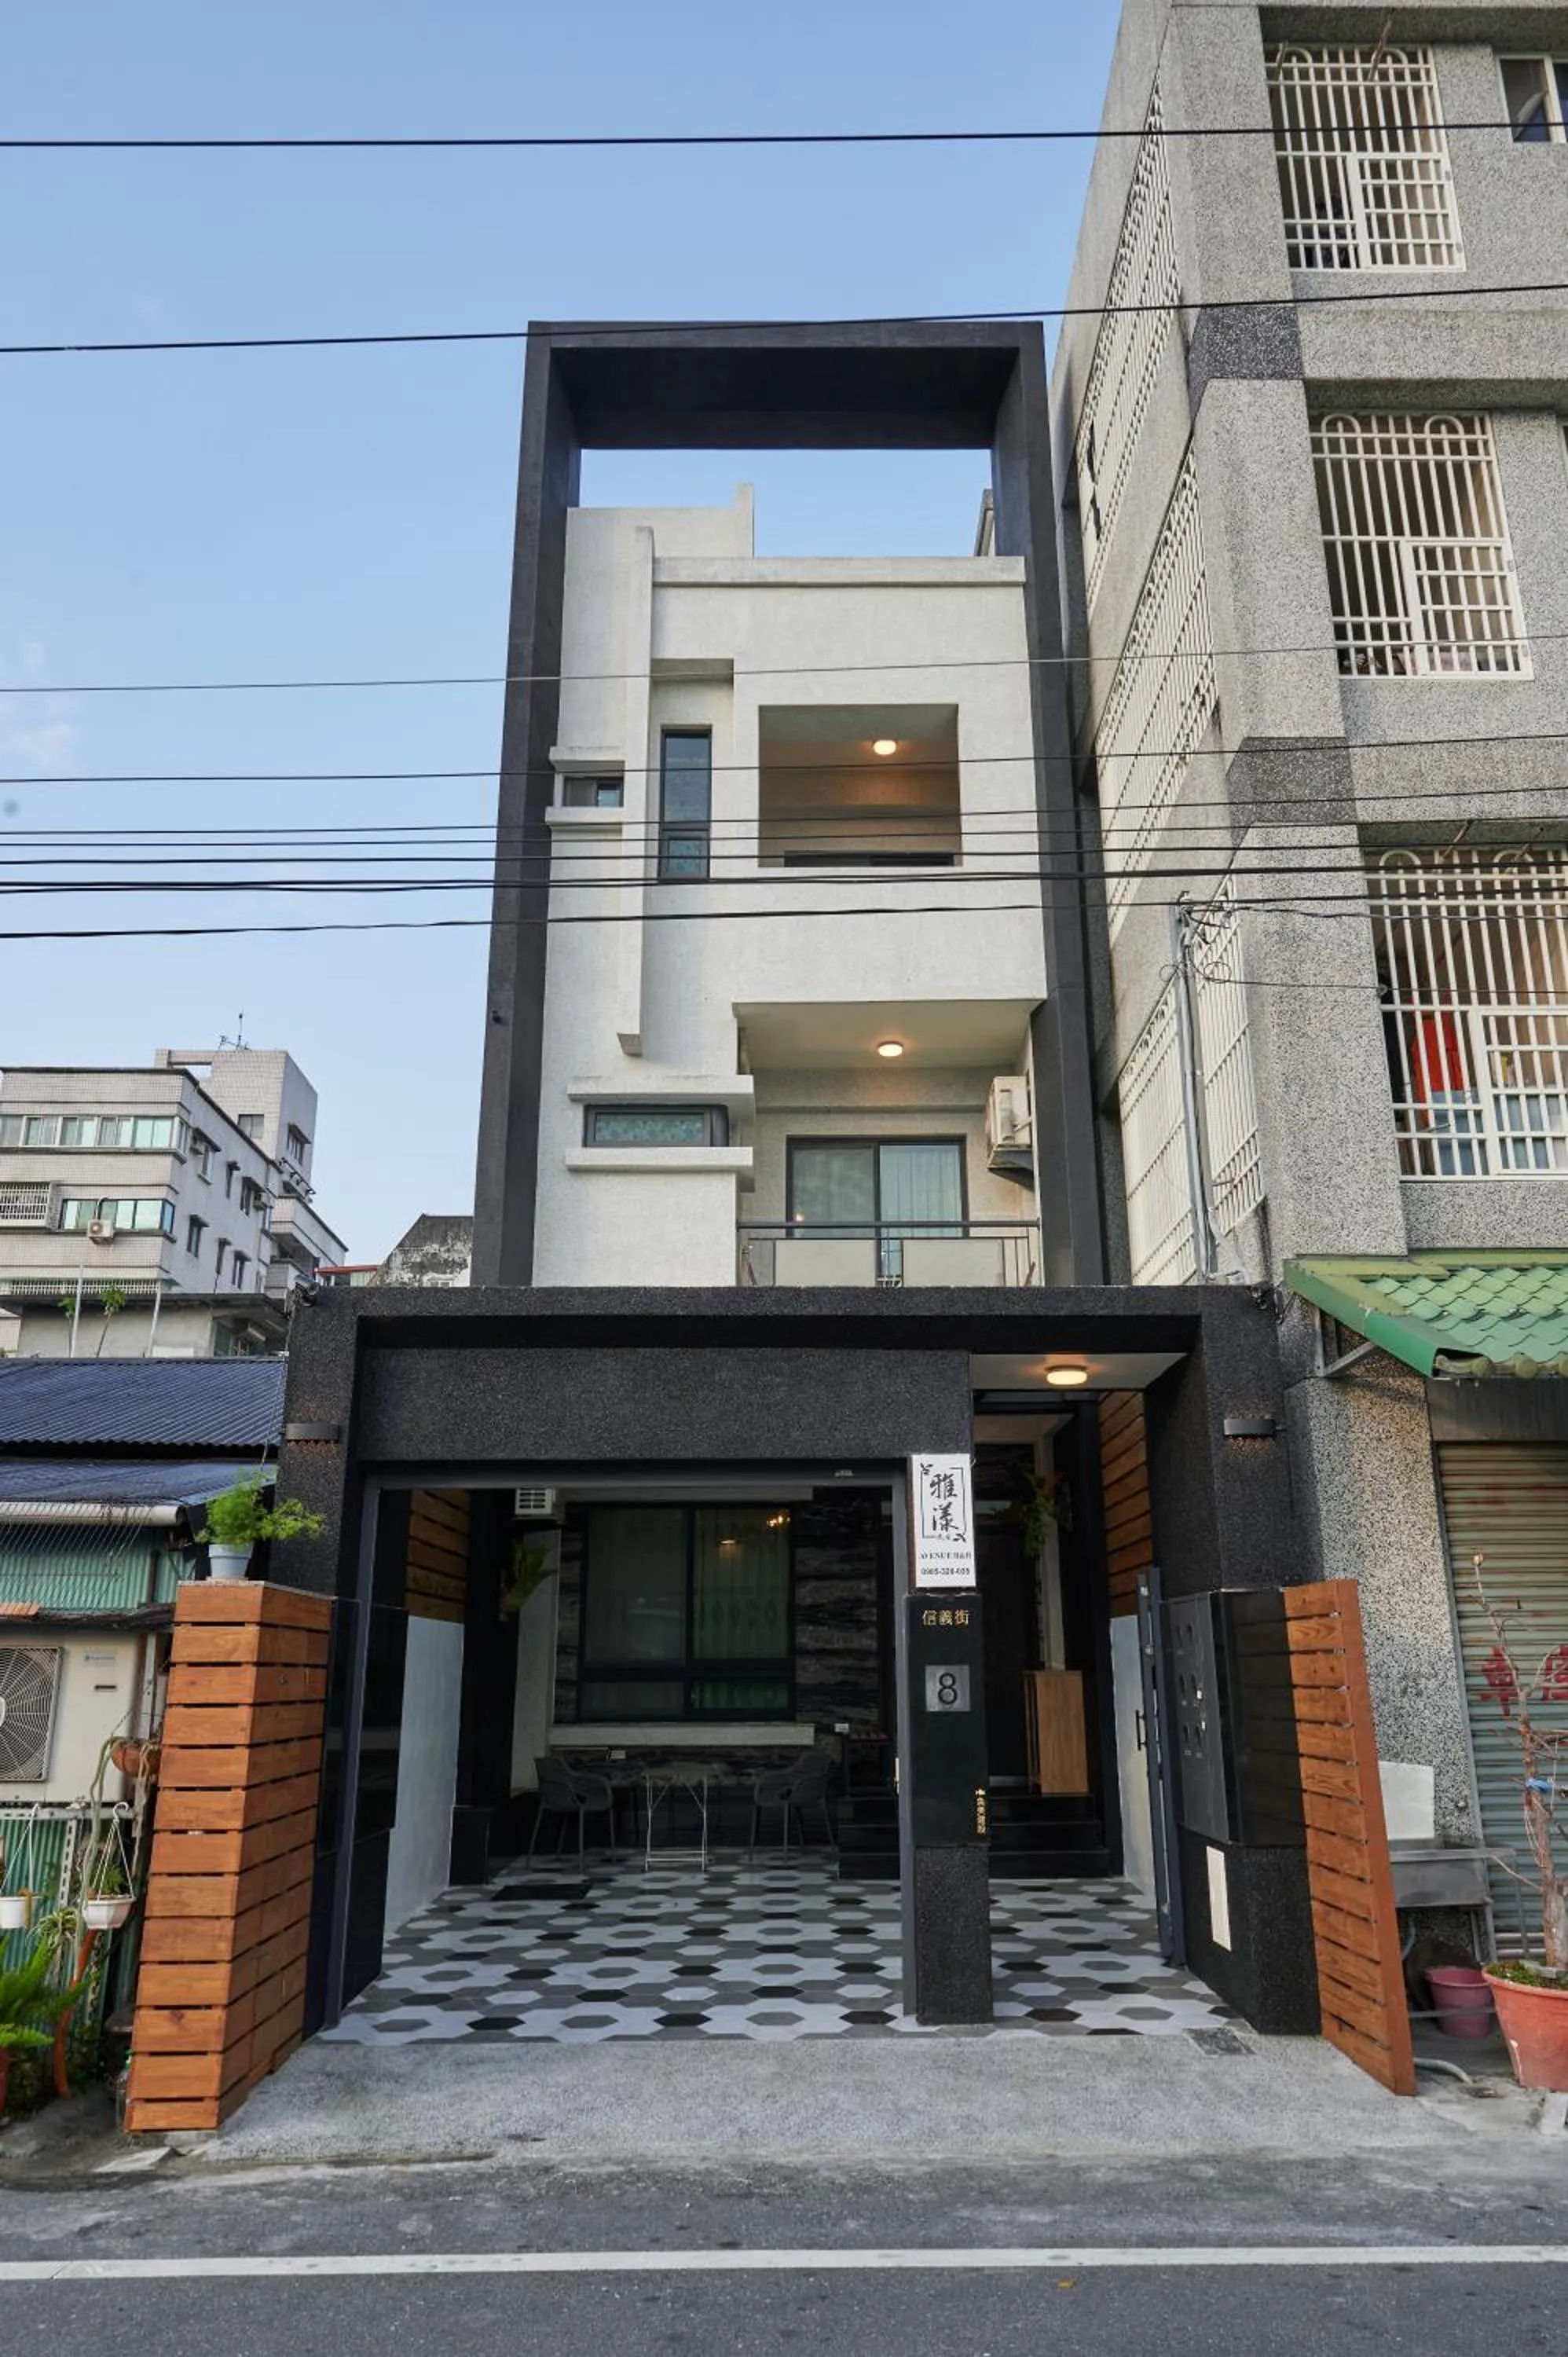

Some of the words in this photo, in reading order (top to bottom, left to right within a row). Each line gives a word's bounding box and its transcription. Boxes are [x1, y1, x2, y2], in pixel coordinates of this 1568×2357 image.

[922, 1609, 970, 1626] 信義街
[938, 1672, 958, 1705] 8
